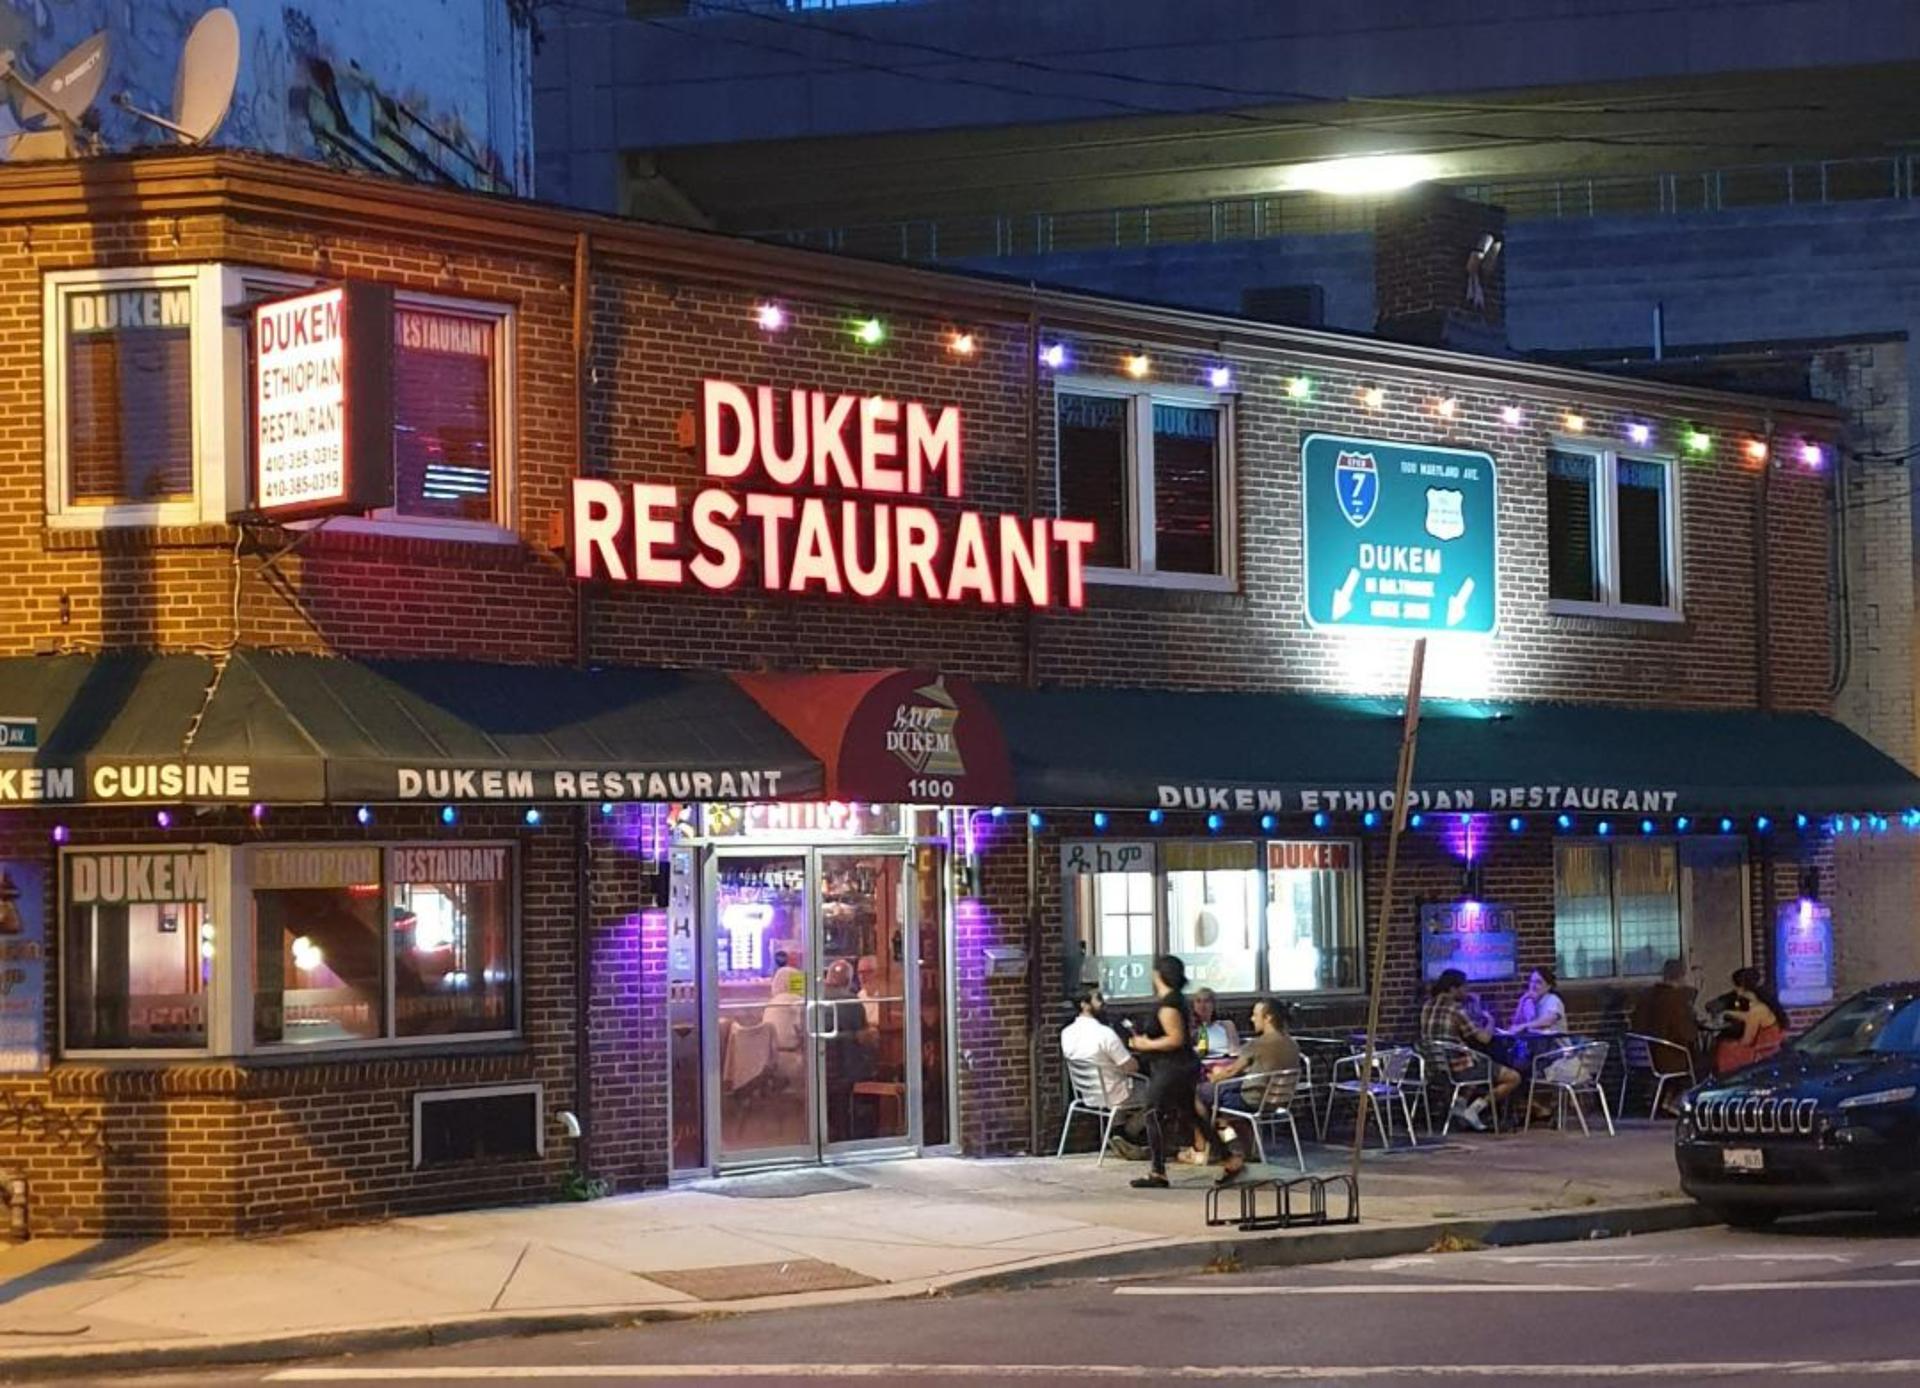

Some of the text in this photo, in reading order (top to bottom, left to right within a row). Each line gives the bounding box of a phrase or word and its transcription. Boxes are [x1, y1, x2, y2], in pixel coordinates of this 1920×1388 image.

[72, 290, 190, 330] DUKEM
[261, 301, 346, 354] DUKEM
[400, 312, 490, 357] ESTAURANT
[263, 356, 342, 400] ETHIOPIAN
[261, 401, 343, 445] RESTAURANT
[703, 379, 962, 497] DUKEM
[1351, 472, 1367, 498] 7
[572, 478, 1095, 608] RESTAURANT
[1359, 543, 1442, 574] DUKEM
[886, 731, 949, 752] DUKEM
[94, 765, 250, 798] CUISINE
[397, 769, 782, 798] DUKEM RESTAURANT
[908, 779, 954, 798] 1100
[1157, 785, 1678, 812] DUKEM ETHIOPIAN RESTAURANT
[255, 850, 374, 884] ETHIOPIAN
[393, 848, 507, 882] RESTAURANT
[1269, 843, 1350, 869] DUKEM
[72, 854, 207, 902] DUKEM
